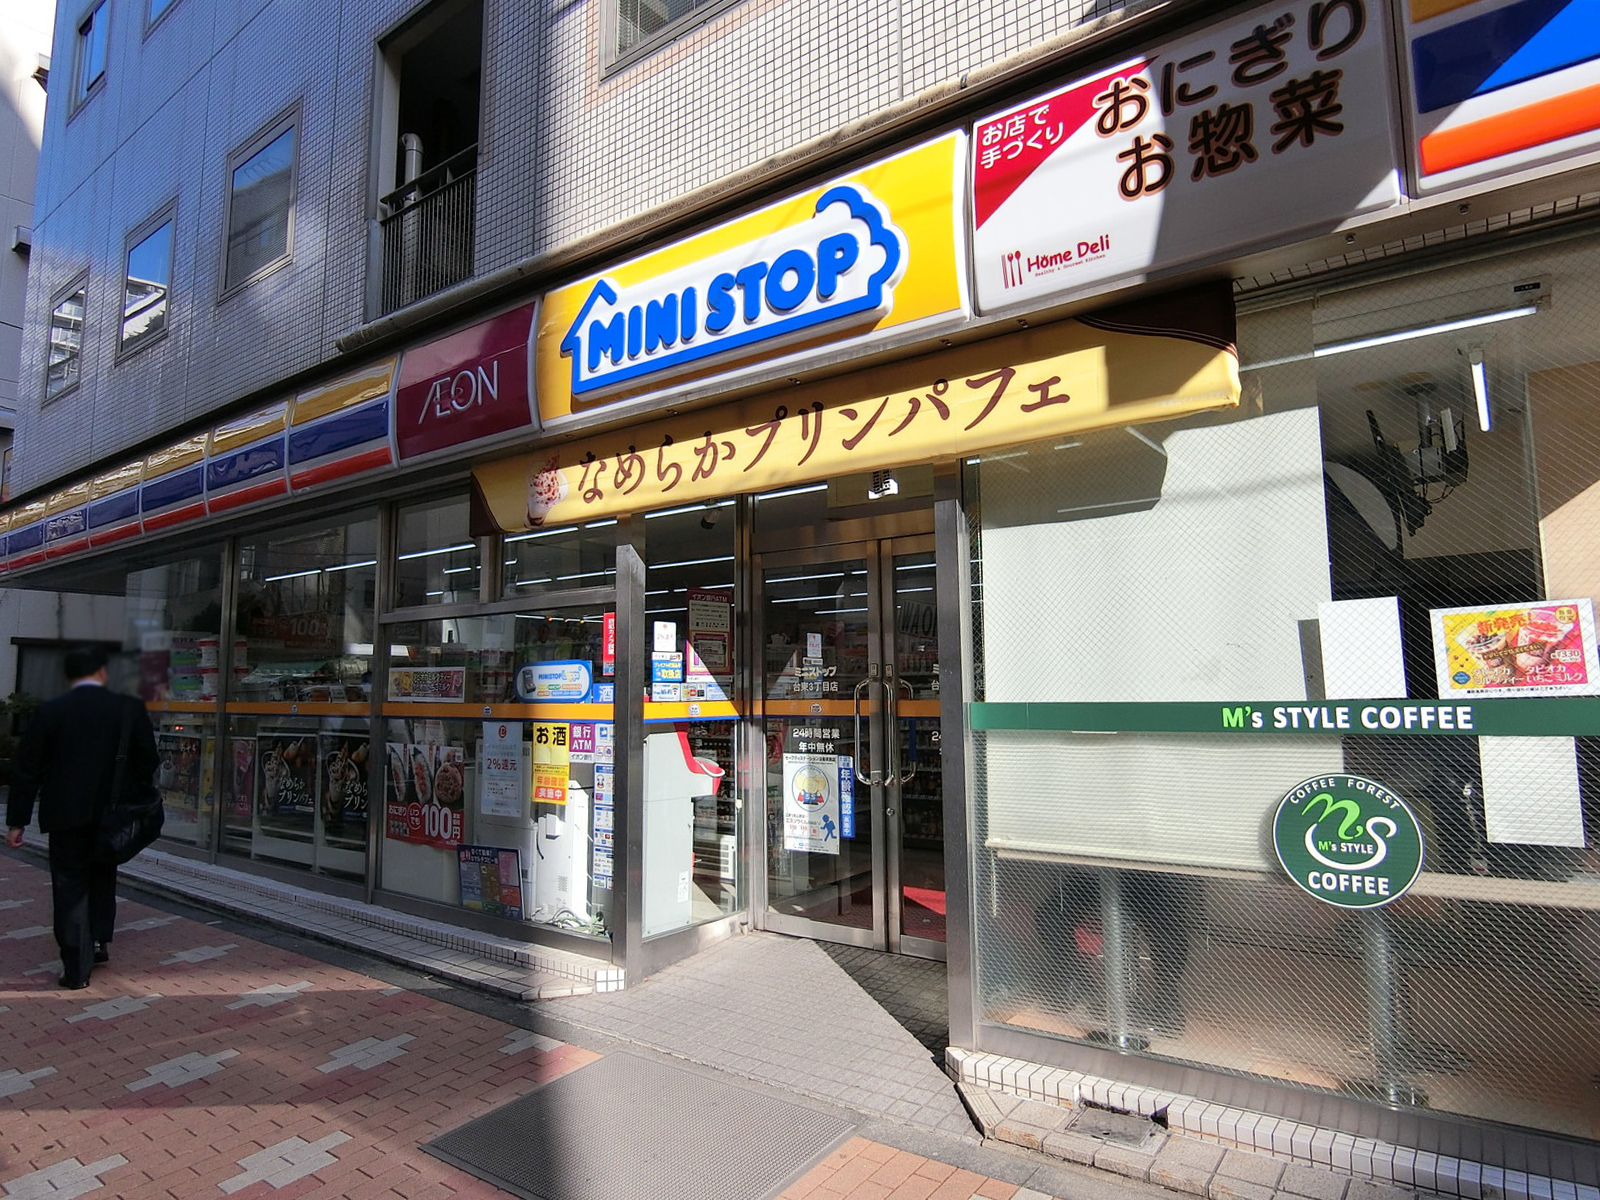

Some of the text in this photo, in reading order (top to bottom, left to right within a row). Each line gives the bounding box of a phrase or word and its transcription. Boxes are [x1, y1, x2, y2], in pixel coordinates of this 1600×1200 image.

[1094, 0, 1367, 138] おにぎり
[981, 104, 1050, 146] お店で
[1117, 68, 1344, 200] お惣菜
[980, 122, 1065, 169] 手づくり
[1027, 234, 1110, 272] Home Deli
[577, 366, 1070, 504] なめらかプリンパフェ
[794, 666, 838, 677] ミニストップ
[1526, 664, 1566, 673] タピオカ
[793, 681, 839, 692] 台東3丁目店
[1222, 706, 1473, 729] M's STYLE COFFEE
[536, 726, 567, 746] お酒
[572, 726, 591, 738] 銀行
[793, 728, 840, 739] 24時間営業
[572, 740, 592, 750] ATM
[798, 742, 834, 753] 年中無休
[486, 758, 517, 771] 2%還元
[279, 777, 306, 791] なめらか
[278, 791, 314, 804] プリンパフェ
[1290, 778, 1400, 809] COFFEE FOREST
[422, 804, 452, 839] 100
[1318, 841, 1374, 854] M's STYLE
[1307, 871, 1390, 896] COFFEE
